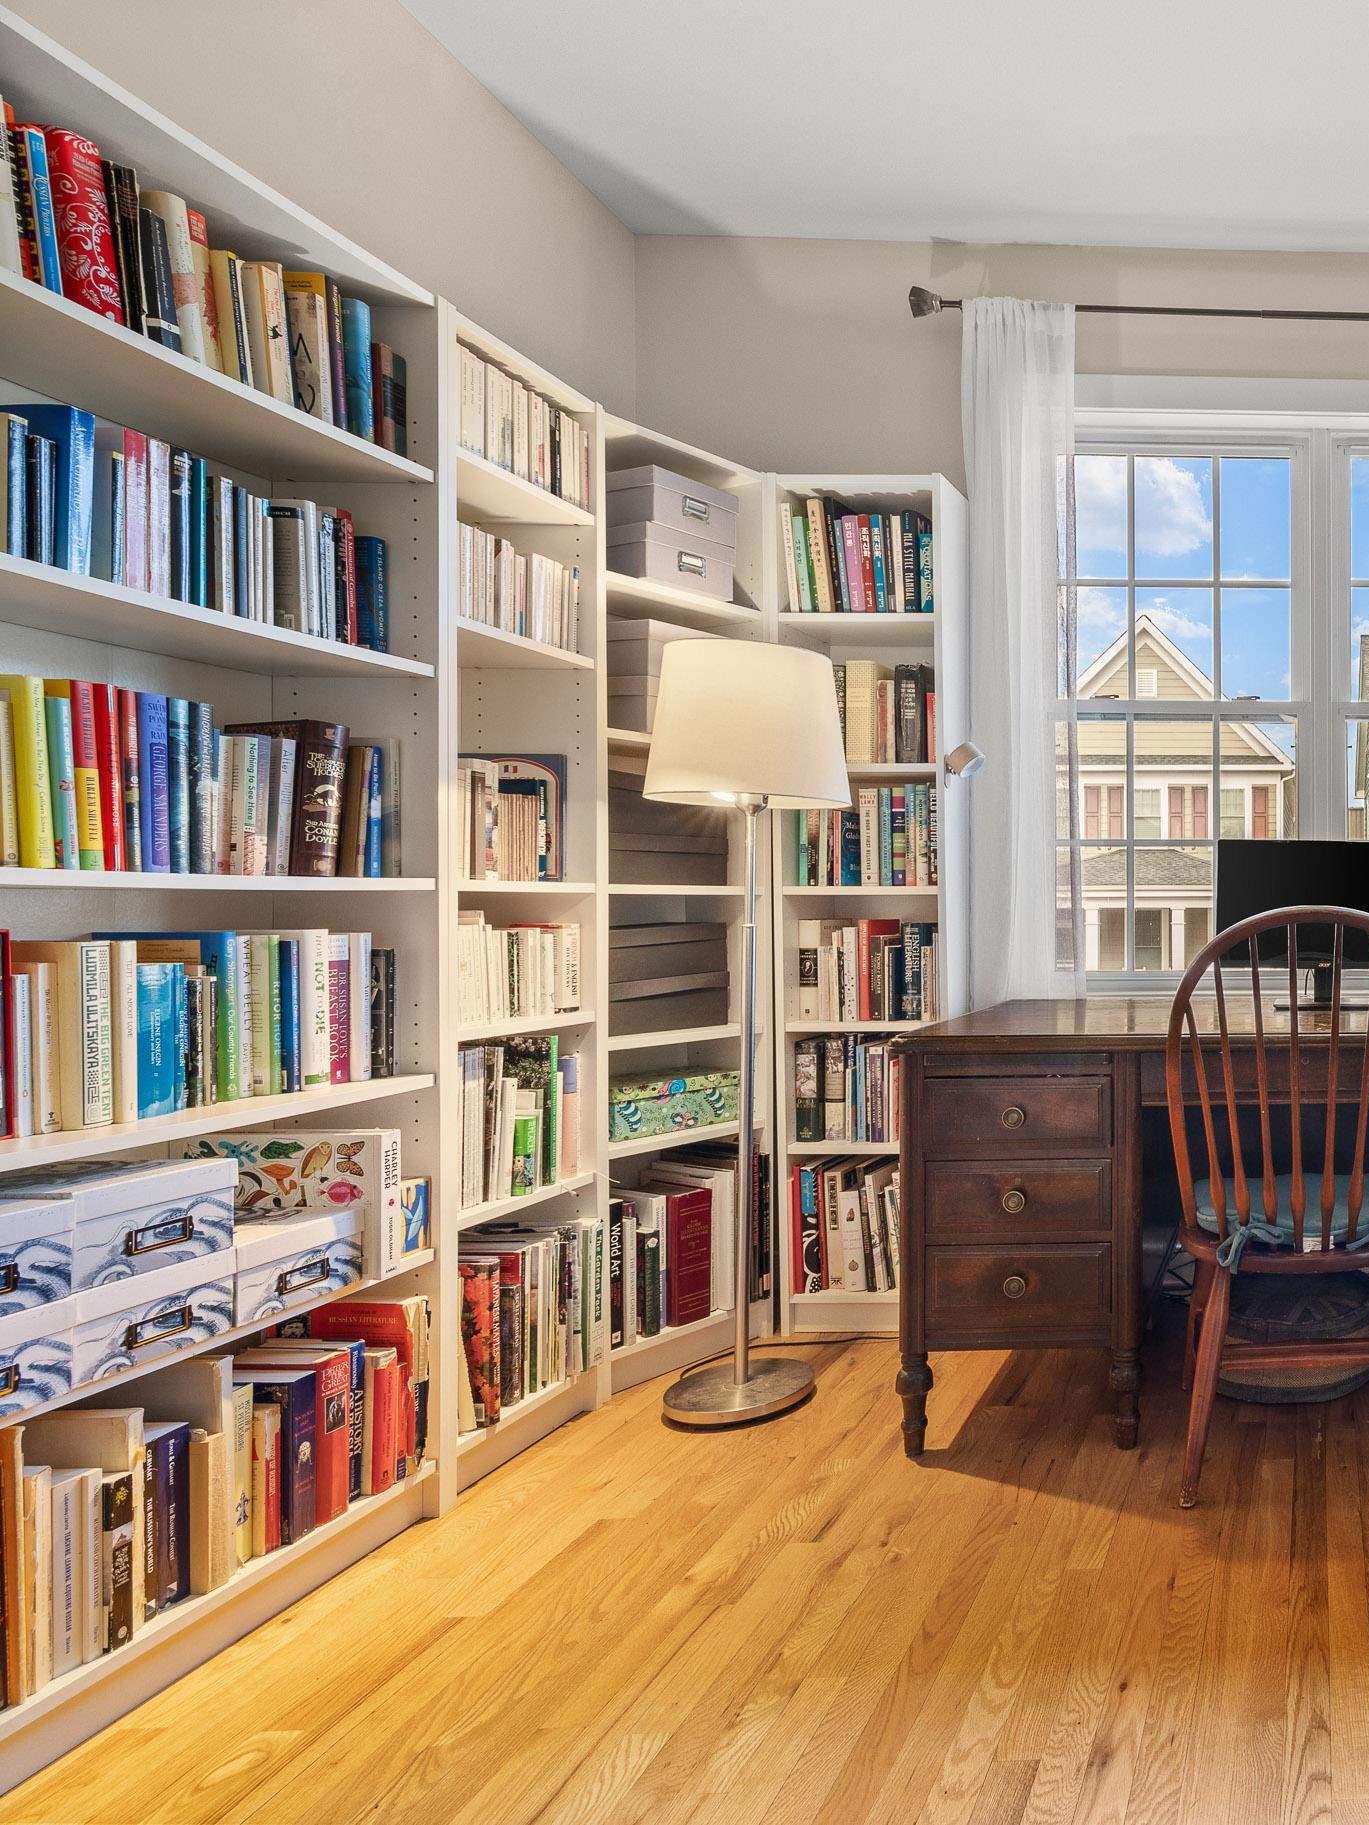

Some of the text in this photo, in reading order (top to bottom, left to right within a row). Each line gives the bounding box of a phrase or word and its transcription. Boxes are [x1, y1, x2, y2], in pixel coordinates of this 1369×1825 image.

[376, 557, 384, 581] ISLAND
[377, 610, 385, 637] WOMEN
[246, 742, 257, 773] Nothing
[281, 749, 293, 775] After
[153, 744, 168, 852] GEORGE SAUNDERS
[247, 785, 256, 799] See
[226, 939, 236, 960] Gary
[904, 934, 912, 983] LITERATURE
[86, 949, 99, 1070] LUDMILA ULITSKAYA
[243, 940, 252, 1033] WHEAT BELLY
[338, 990, 347, 1022] SUSAN
[329, 968, 340, 1063] BREAST BOOK
[100, 1000, 112, 1118] THE BIG GREEN TENT
[227, 1022, 237, 1080] Country Friends
[610, 1222, 621, 1278] World Art
[353, 1402, 363, 1455] HISTORY
